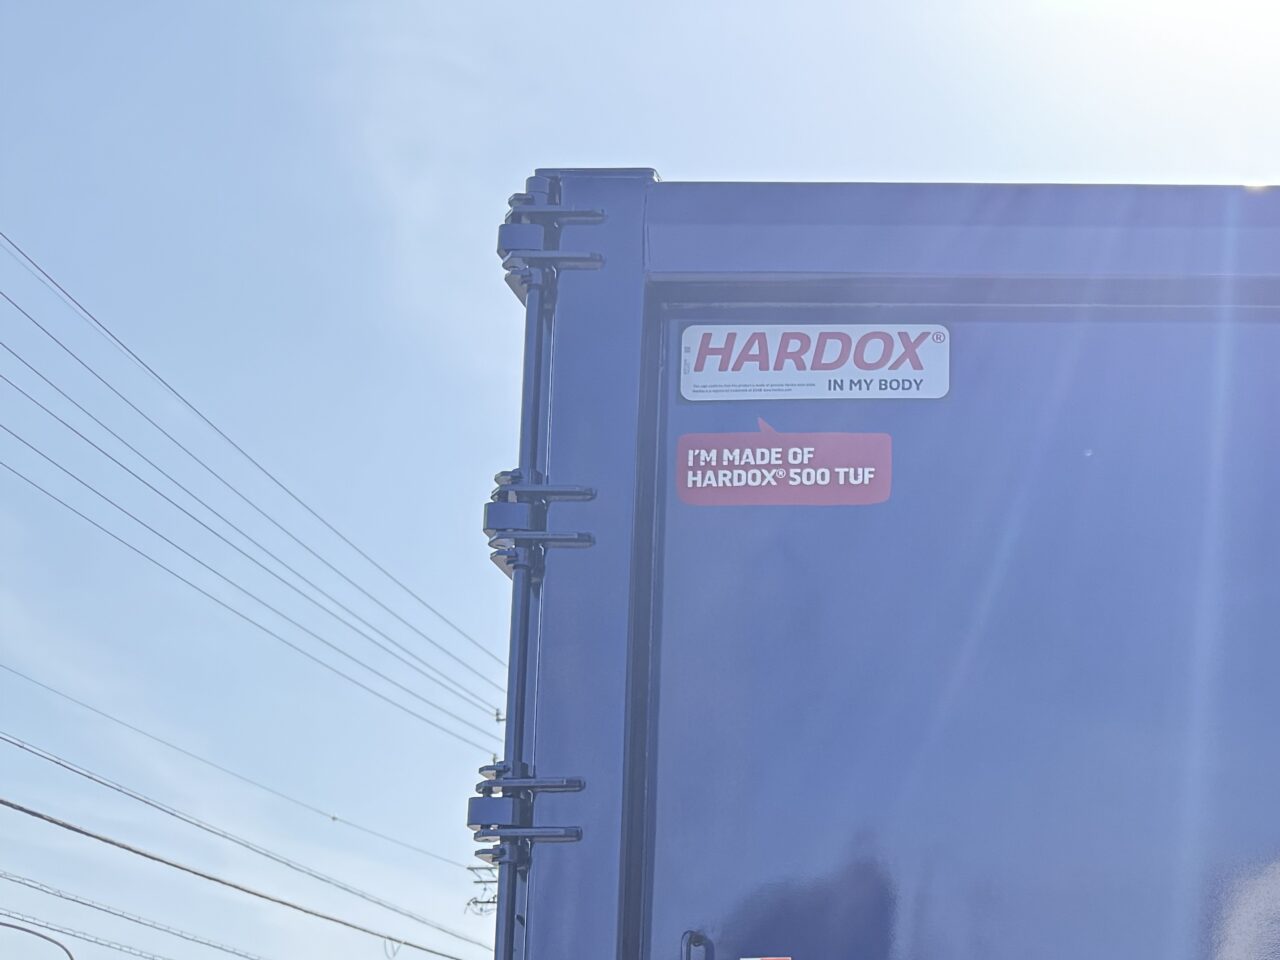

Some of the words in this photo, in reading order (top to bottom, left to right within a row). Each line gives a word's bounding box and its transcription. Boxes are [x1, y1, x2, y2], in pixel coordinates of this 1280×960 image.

[827, 379, 844, 392] IN
[849, 378, 874, 391] MY
[878, 378, 924, 391] BODY
[722, 449, 783, 466] MADE
[788, 447, 815, 464] OF
[788, 469, 830, 486] 500
[835, 467, 875, 485] TUF
